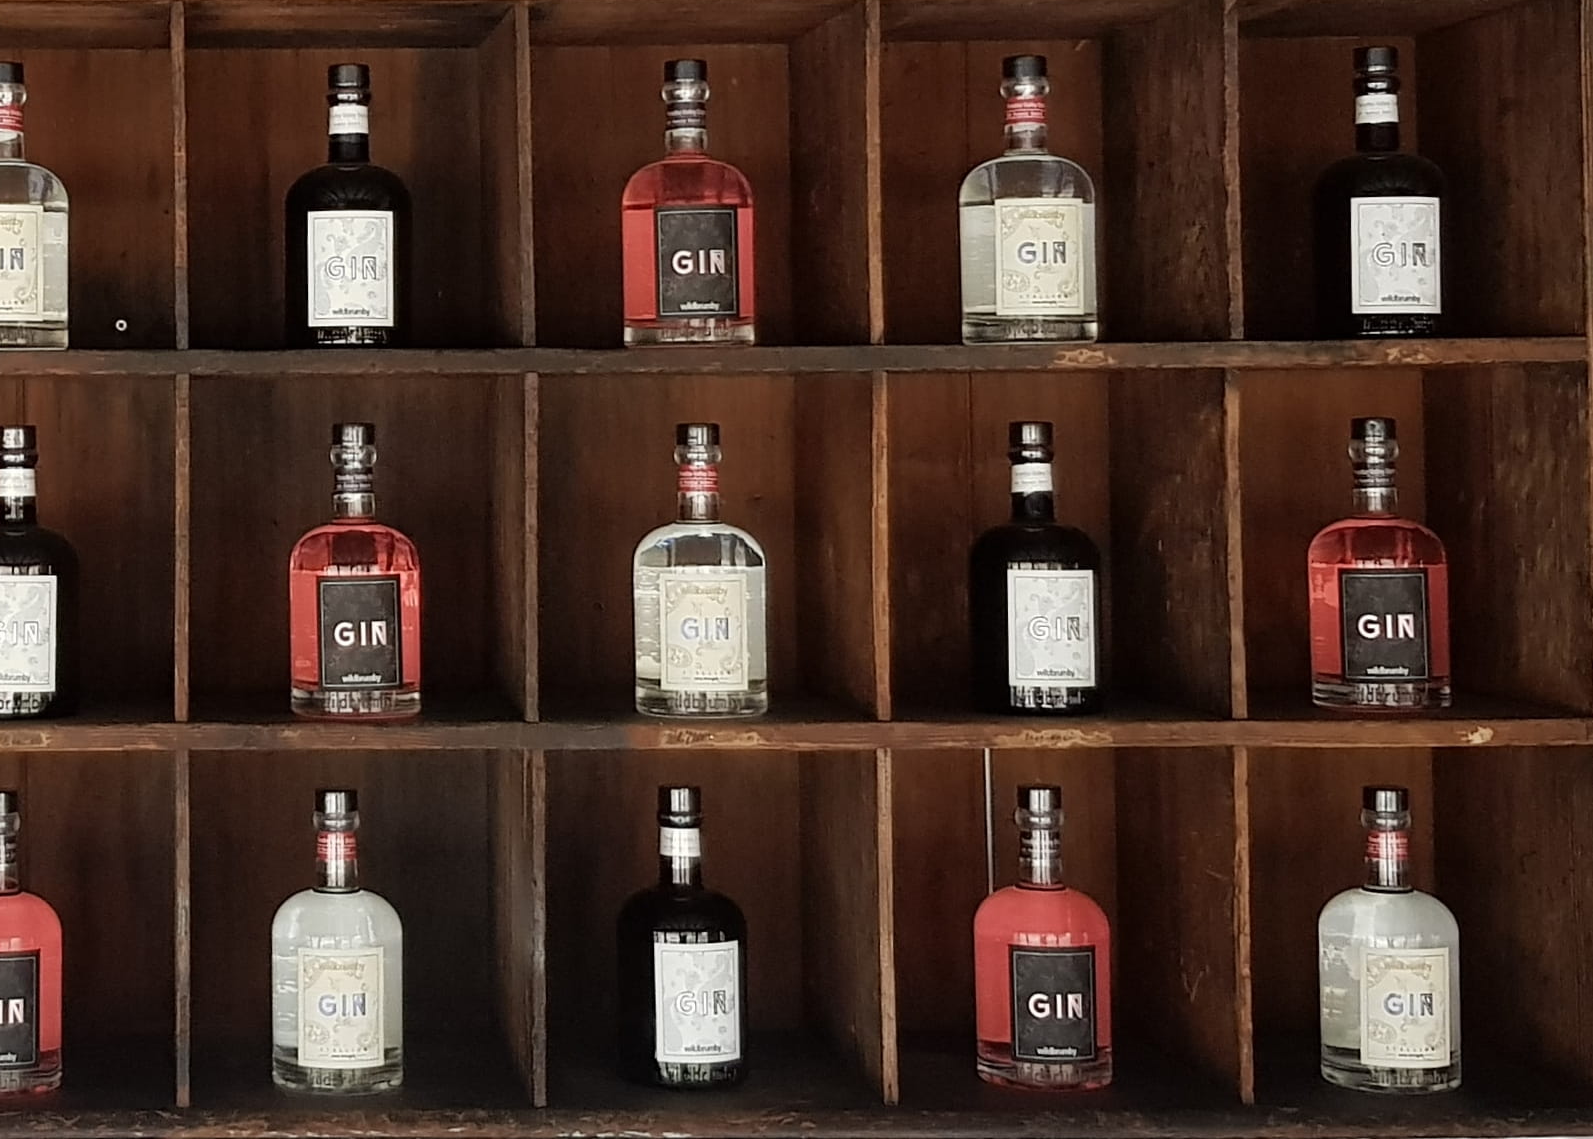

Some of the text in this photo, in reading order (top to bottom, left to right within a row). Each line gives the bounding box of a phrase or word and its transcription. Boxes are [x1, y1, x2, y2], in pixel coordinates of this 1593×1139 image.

[672, 249, 725, 274] GIN
[1018, 241, 1066, 264] GIN
[1373, 243, 1426, 267] GIN
[326, 256, 376, 280] GIN
[334, 621, 387, 646] GIN
[681, 617, 729, 640] GIN
[1029, 616, 1080, 640] GIN
[1358, 614, 1415, 639] GIN
[318, 994, 366, 1017] GIN
[676, 991, 727, 1015] GIN
[1028, 993, 1082, 1019] GIN
[1384, 993, 1433, 1016] GIN
